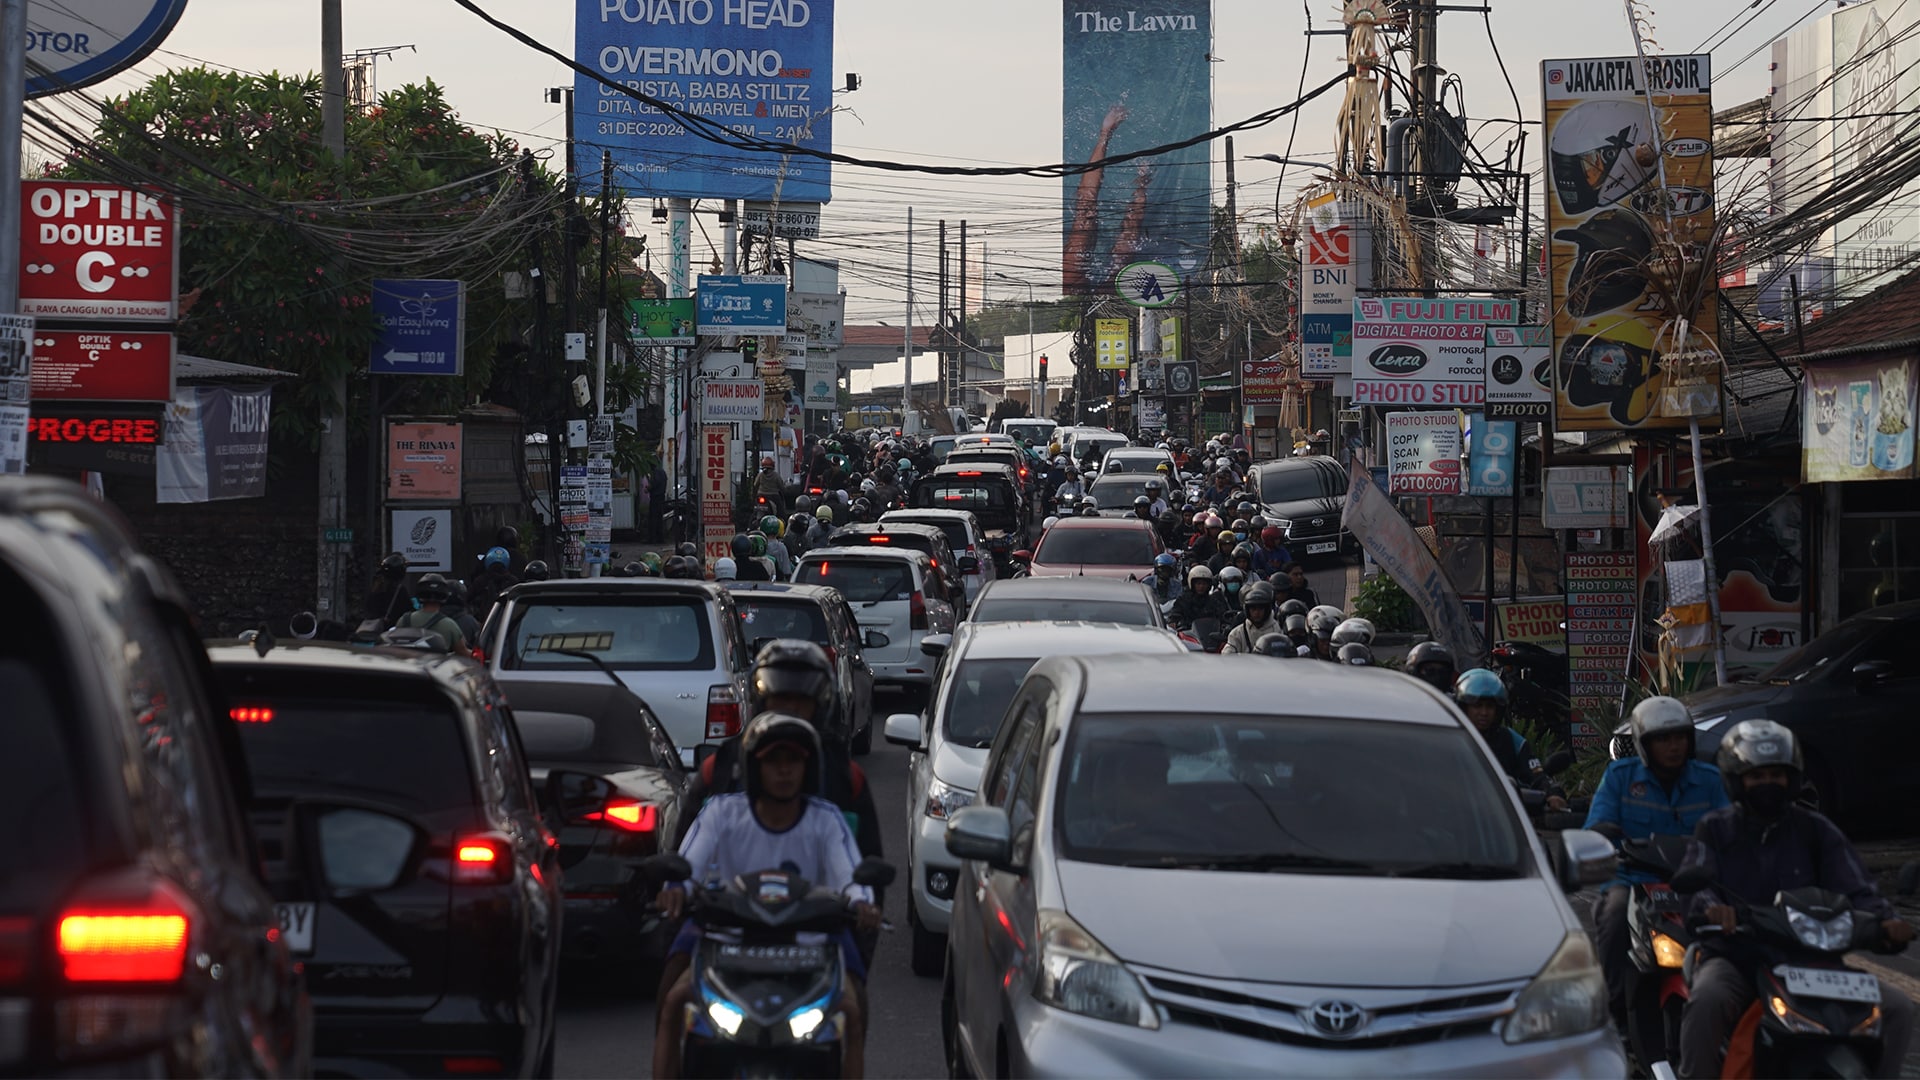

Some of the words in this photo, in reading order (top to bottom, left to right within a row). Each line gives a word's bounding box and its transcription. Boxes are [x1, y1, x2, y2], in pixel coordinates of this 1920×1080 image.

[600, 0, 713, 25] POTATO
[723, 0, 811, 29] HEAD
[1075, 11, 1123, 33] The
[1127, 11, 1198, 32] Lawn
[598, 45, 783, 77] OVERMONO
[689, 82, 743, 100] BABA
[745, 84, 811, 102] STILTZ
[598, 99, 637, 116] DITA,
[690, 101, 752, 118] MARVEL
[755, 102, 768, 118] &
[772, 104, 811, 119] IMEN
[598, 122, 615, 136] 31
[616, 122, 649, 136] DEC
[650, 122, 686, 137] 2024
[720, 125, 731, 137] 4
[732, 125, 755, 137] PM
[775, 126, 785, 138] 2
[635, 163, 668, 173] Online
[731, 165, 803, 177] potatohea.co
[31, 187, 166, 221] OPTIK
[786, 214, 803, 224] 860
[805, 215, 817, 225] 07
[40, 223, 163, 247] DOUBLE
[1858, 219, 1894, 241] ORGANIC
[76, 250, 116, 294] C
[1313, 269, 1348, 285] BNI
[24, 305, 35, 314] JL.
[36, 305, 59, 314] RAYA
[60, 305, 99, 315] CANGGU
[100, 306, 115, 315] NO
[117, 306, 127, 315] 18
[129, 307, 167, 316] BADUNG
[1390, 302, 1446, 320] FUJI
[1454, 303, 1513, 321] FILM
[640, 312, 673, 322] HOYT
[711, 315, 734, 324] MAX
[1306, 322, 1331, 335] ATM
[1356, 325, 1407, 338] DIGITAL
[1410, 326, 1456, 339] PHOTO
[1460, 326, 1469, 338] &
[78, 335, 112, 344] OPTIK
[88, 349, 100, 361] C
[1439, 346, 1486, 354] PHOTOGRA
[420, 352, 436, 364] 100
[436, 352, 446, 364] M
[1374, 346, 1421, 367] Lenza
[1466, 357, 1474, 365] &
[1243, 377, 1275, 386] SAMBAL
[707, 383, 734, 398] PITUAH
[735, 383, 760, 399] BUNDO
[1355, 382, 1426, 402] PHOTO
[1432, 384, 1486, 404] STUD
[230, 395, 259, 433] ALDI
[708, 405, 737, 416] MASAKAN
[1492, 403, 1548, 416] PHOTO
[1389, 416, 1421, 427] PHOTO
[1423, 415, 1458, 426] STUDIO
[396, 440, 416, 450] THE
[418, 440, 456, 450] RINAYA
[1392, 433, 1419, 445] COPY
[1393, 448, 1420, 459] SCAN
[706, 433, 725, 491] KUNCI
[1395, 460, 1424, 472] PRINT
[1393, 476, 1458, 491] FOTOCOPY
[560, 489, 586, 497] PHOTO
[705, 541, 733, 557] KEY
[1569, 555, 1614, 565] PHOTO
[1571, 568, 1620, 578] PHOTO
[1625, 568, 1634, 577] K
[1569, 581, 1610, 591] PHOTO
[1577, 594, 1624, 604] PHOTO
[1506, 603, 1566, 622] PHOTO
[1574, 607, 1617, 617] CETAK
[1570, 621, 1608, 630] SCAN
[1613, 621, 1623, 630] &
[1585, 633, 1630, 642] FOTOC
[1573, 672, 1608, 682] VIDEO
[1575, 684, 1624, 694] KARTU
